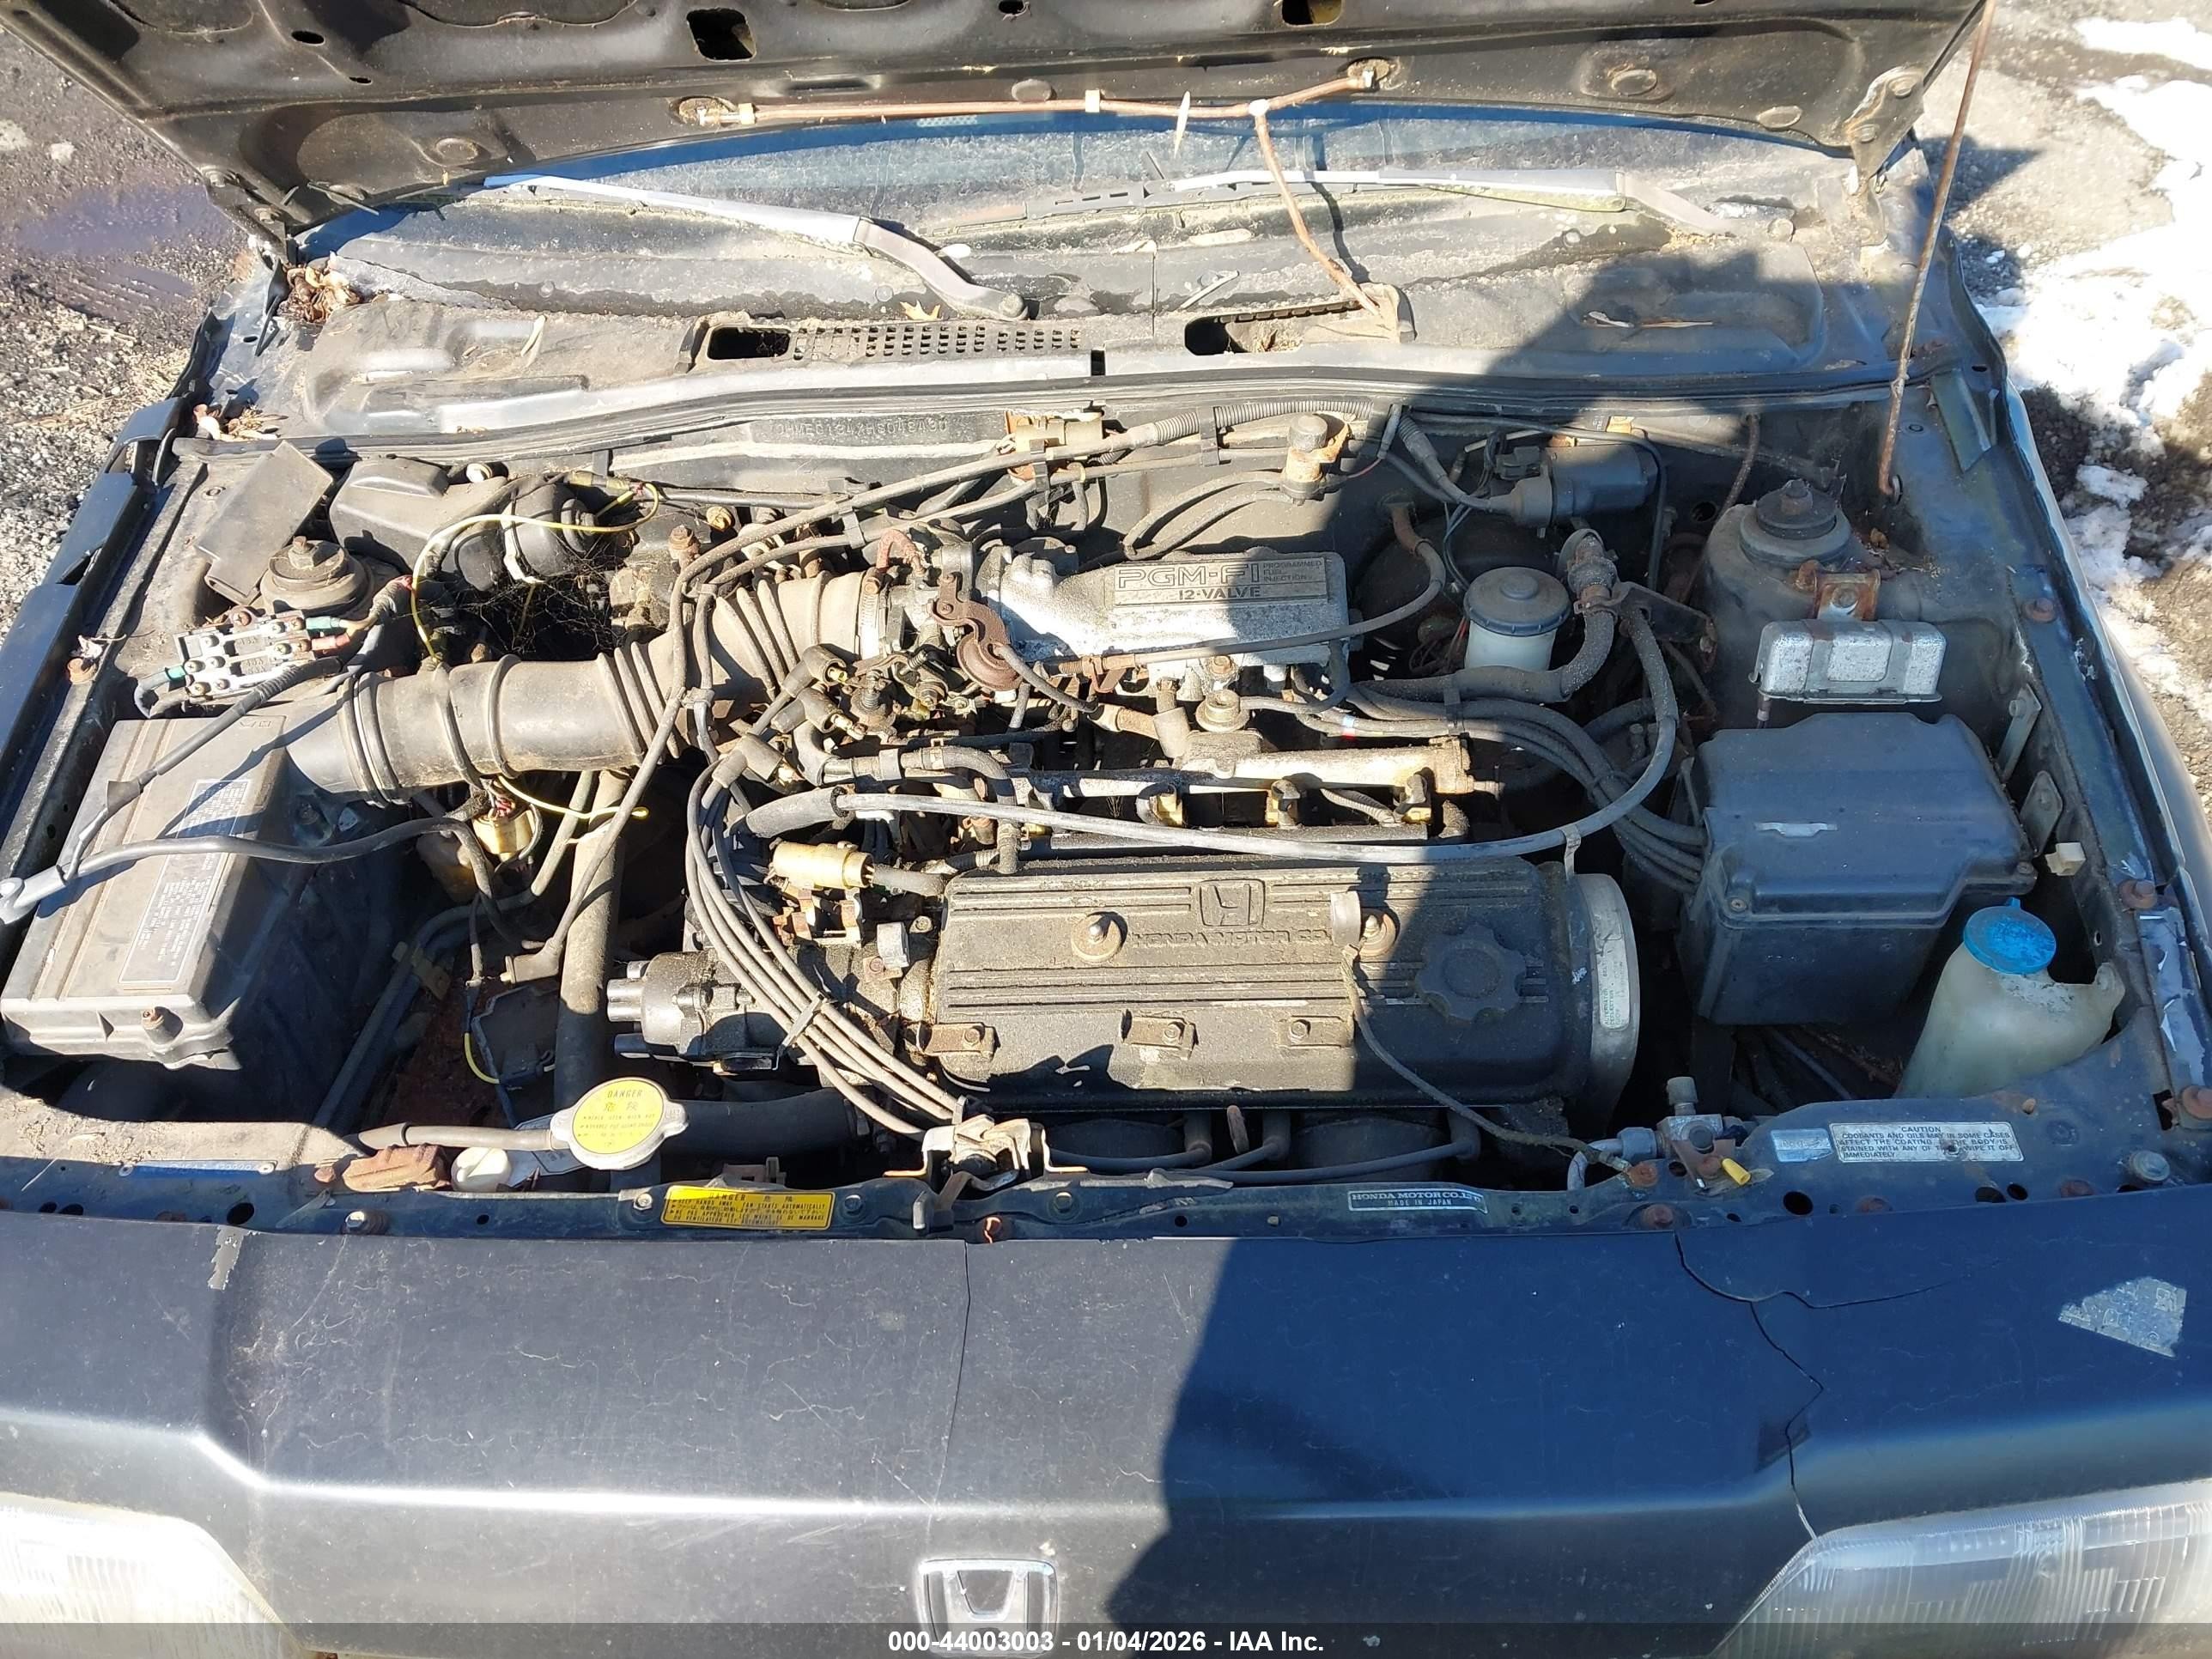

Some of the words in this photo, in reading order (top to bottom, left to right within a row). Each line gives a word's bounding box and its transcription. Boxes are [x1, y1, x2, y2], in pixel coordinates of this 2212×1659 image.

[1119, 563, 1260, 588] PGM-FI
[1179, 586, 1261, 600] 12-VALVE
[709, 1193, 746, 1201] DANGER
